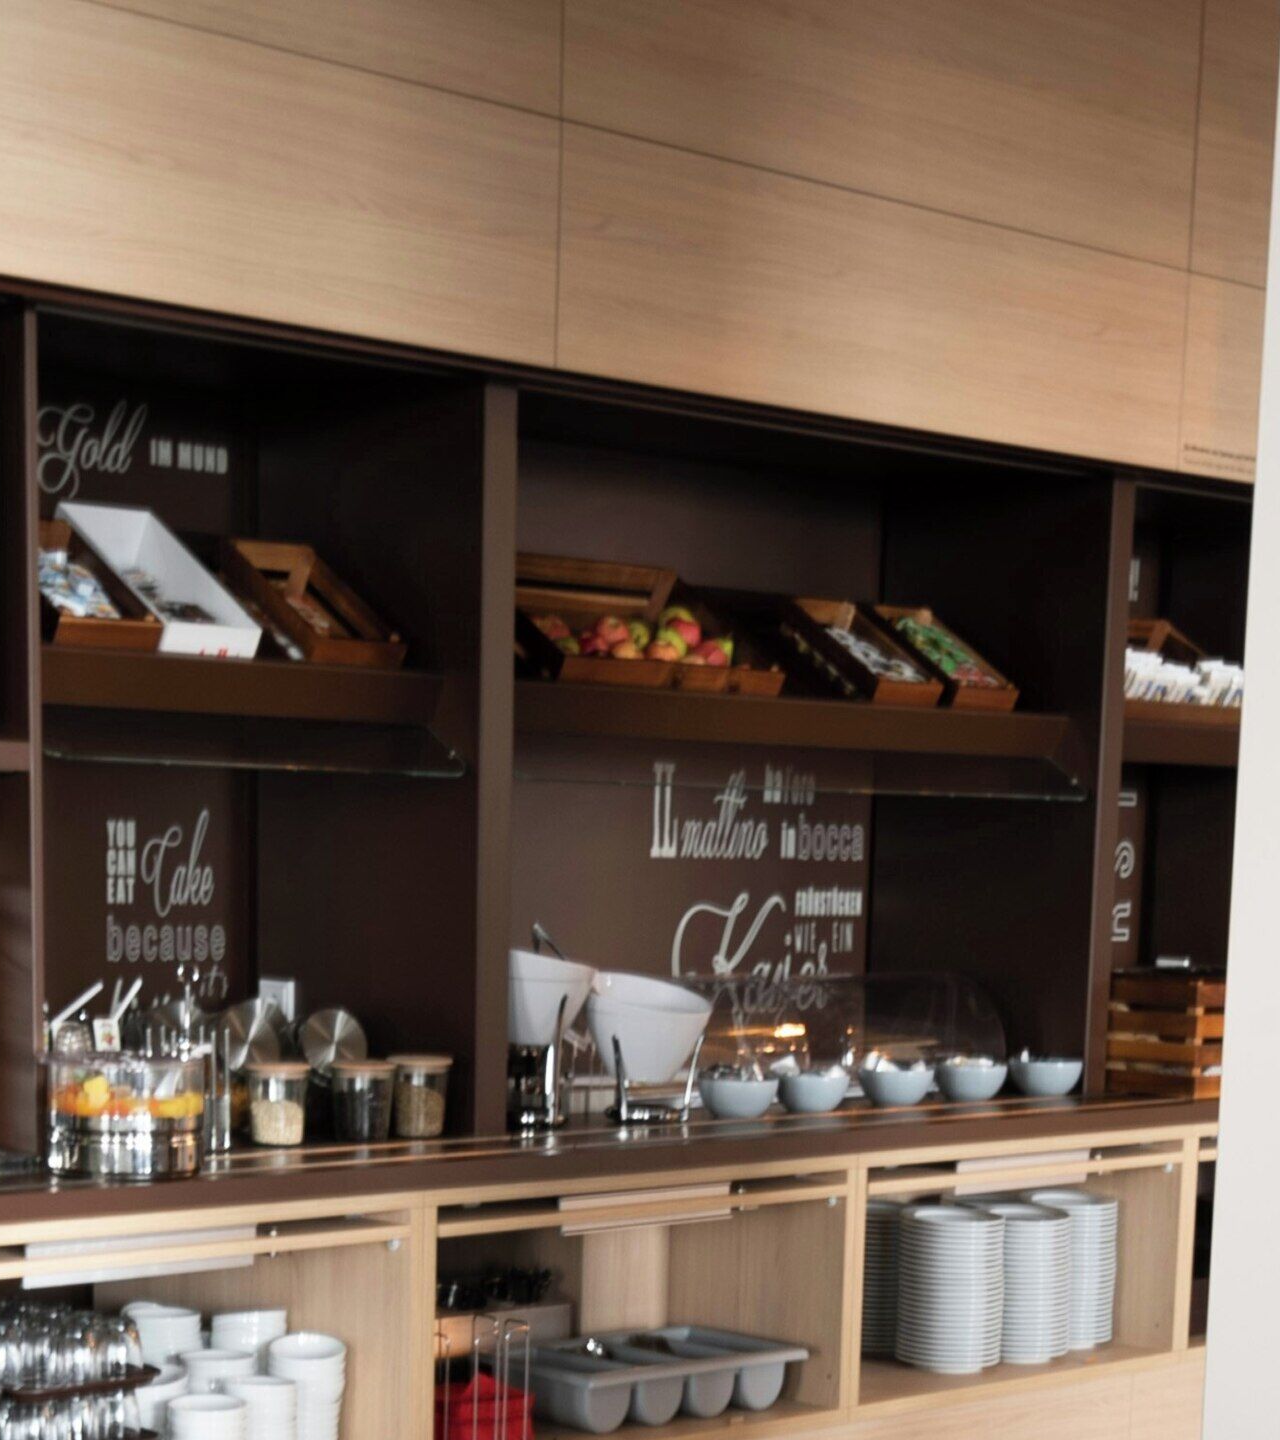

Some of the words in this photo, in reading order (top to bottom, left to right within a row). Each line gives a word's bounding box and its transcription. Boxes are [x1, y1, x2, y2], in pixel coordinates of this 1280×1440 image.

[37, 402, 147, 500] Gold
[798, 812, 864, 861] bocca
[106, 848, 136, 877] CAN
[106, 820, 136, 848] YOU
[140, 808, 215, 918] Cake
[106, 876, 135, 905] EAT
[106, 914, 226, 962] because
[794, 922, 816, 954] WIE
